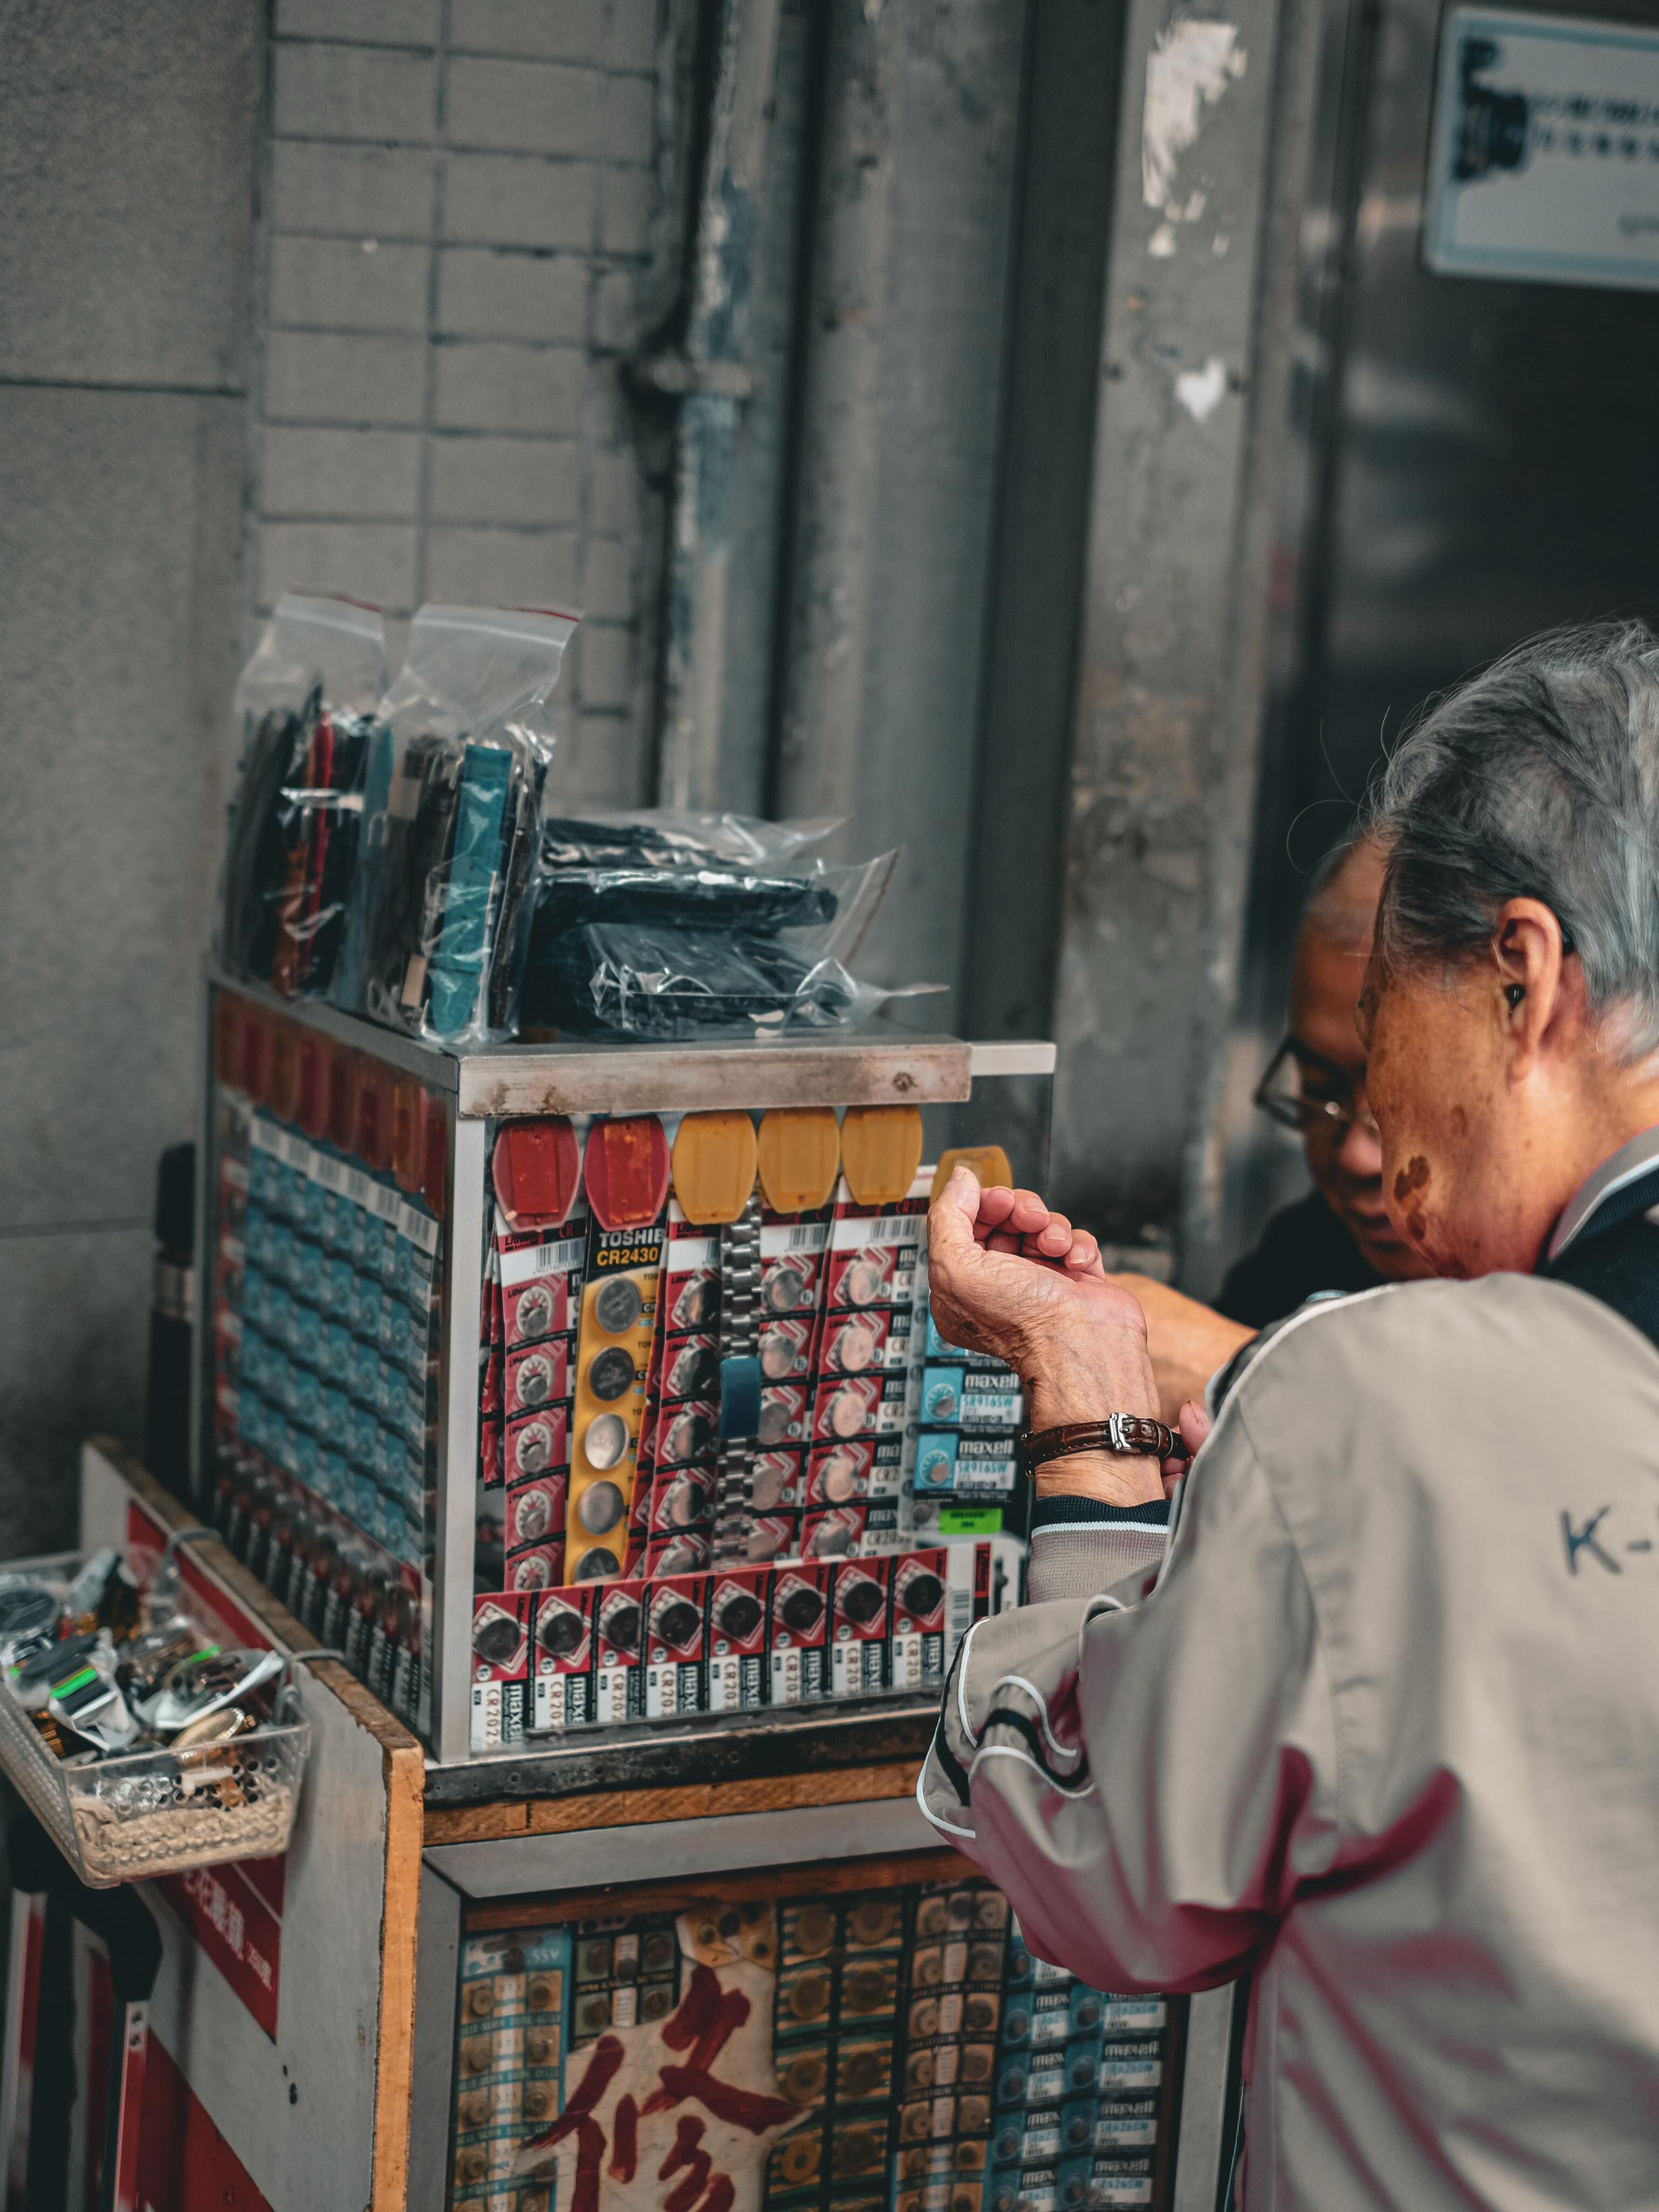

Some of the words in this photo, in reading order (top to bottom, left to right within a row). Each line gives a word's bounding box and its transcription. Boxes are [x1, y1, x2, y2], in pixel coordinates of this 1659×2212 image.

[596, 1246, 659, 1267] CR2430
[965, 1373, 1020, 1390] maxell
[958, 1439, 1015, 1455] maxell
[1105, 2041, 1159, 2056] maxell
